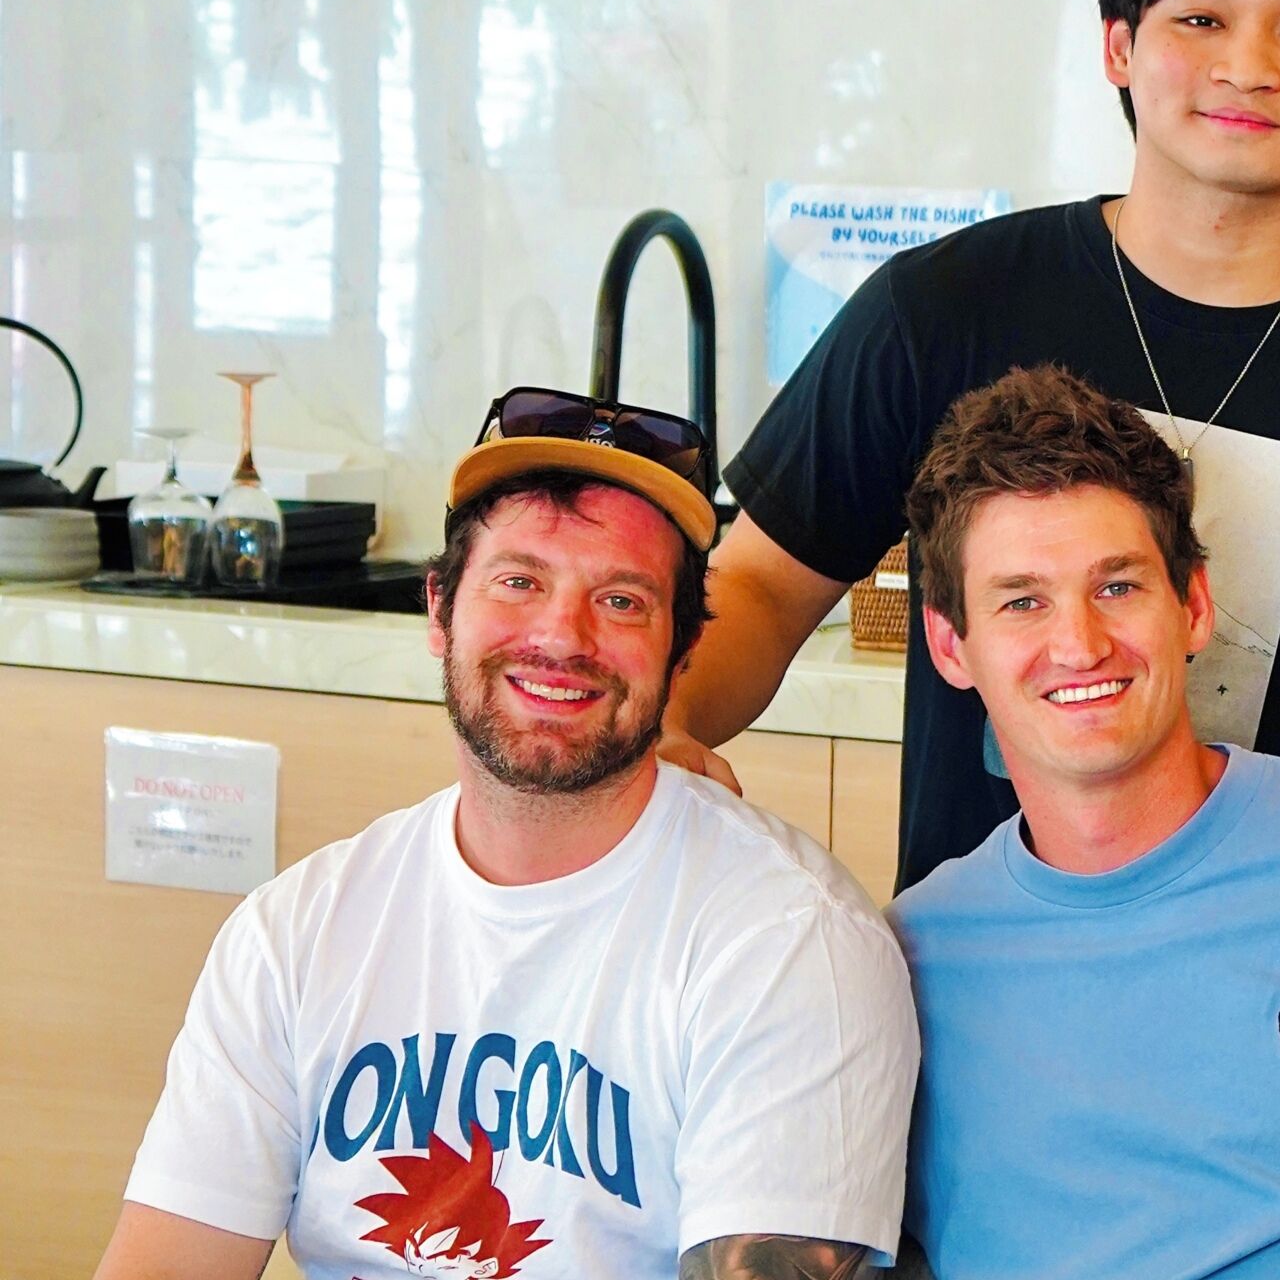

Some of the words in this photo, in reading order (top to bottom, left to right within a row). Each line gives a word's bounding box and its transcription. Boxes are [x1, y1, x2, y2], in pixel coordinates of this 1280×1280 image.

[790, 202, 847, 220] PLEASE
[850, 205, 894, 222] WASH
[901, 207, 928, 222] THE
[832, 227, 852, 243] BY
[134, 777, 158, 795] DO
[199, 783, 246, 803] OPEN
